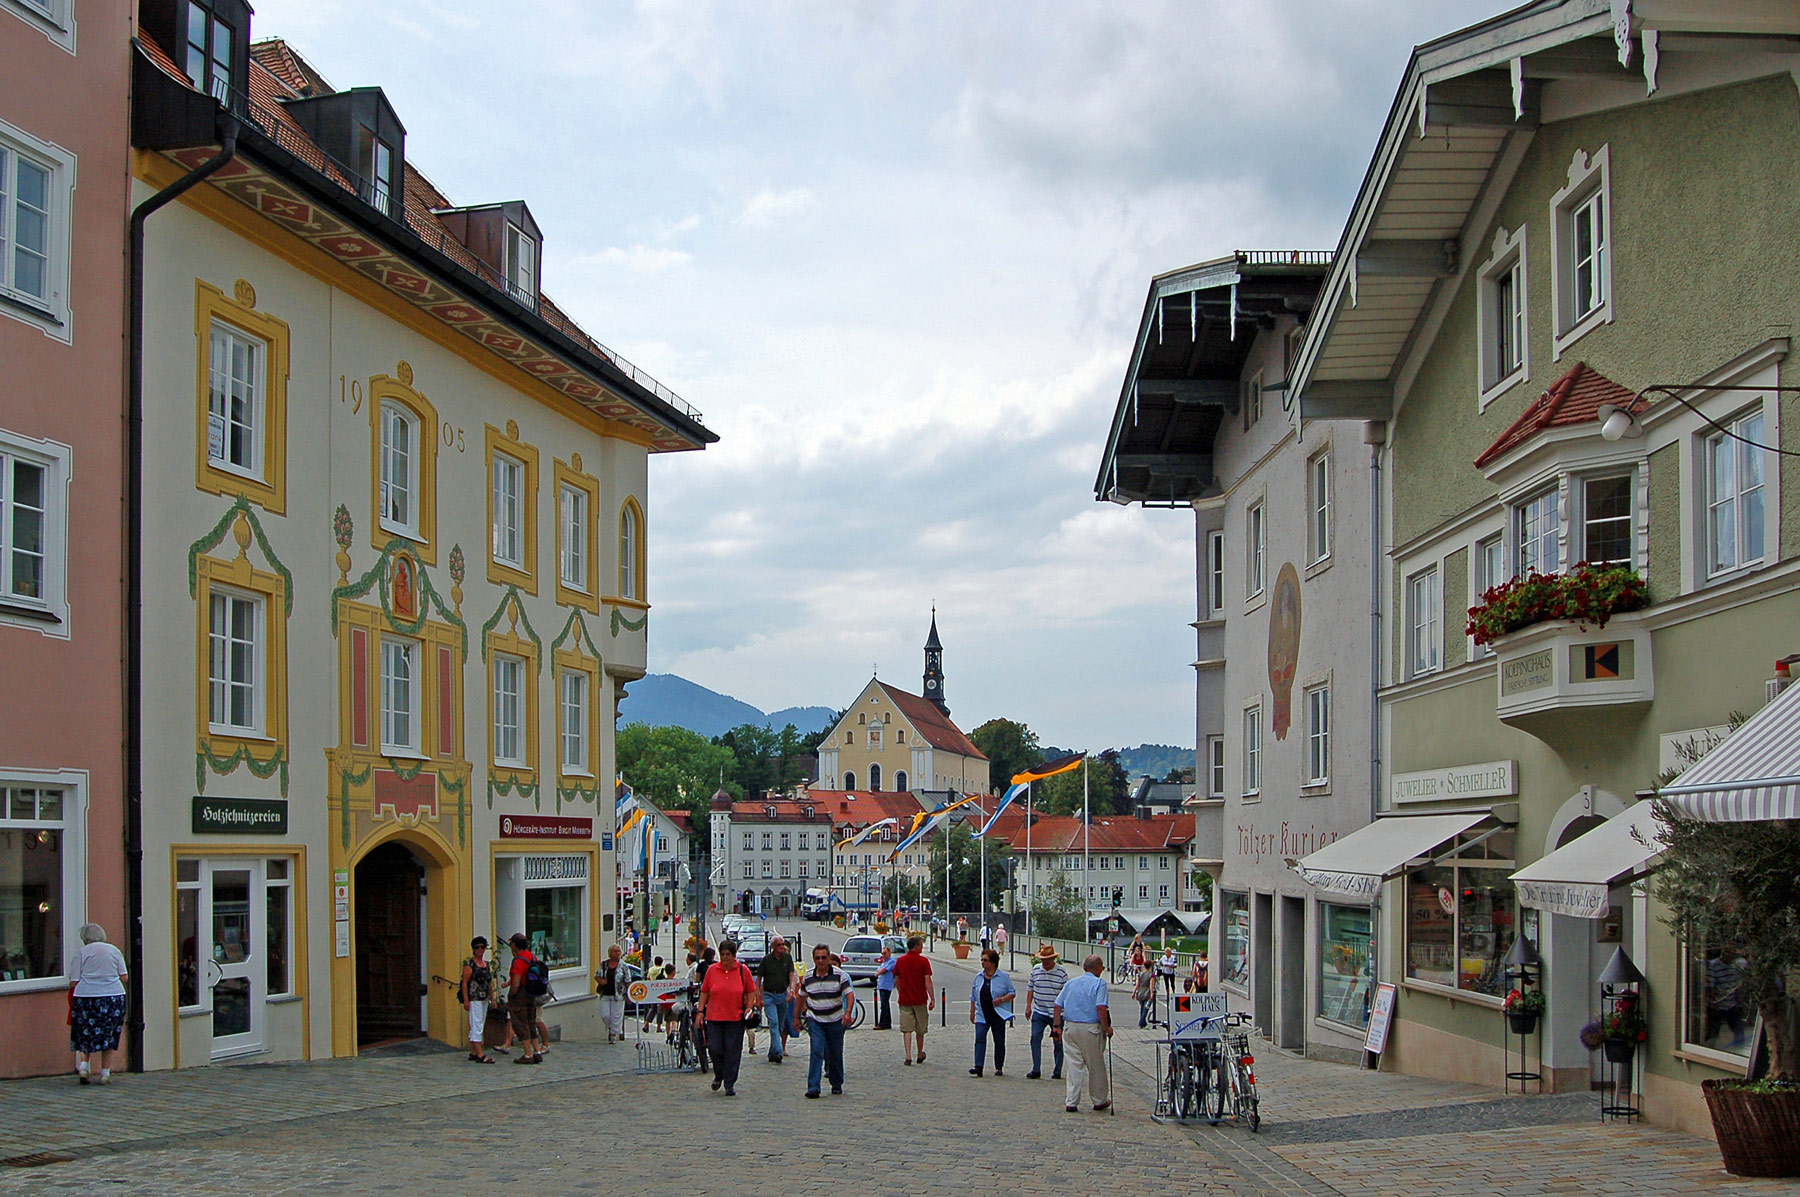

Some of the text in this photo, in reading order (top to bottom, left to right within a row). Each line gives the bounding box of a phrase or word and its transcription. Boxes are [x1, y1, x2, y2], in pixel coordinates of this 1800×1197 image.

[340, 374, 465, 453] 19 05
[1505, 653, 1551, 679] KOLPINGHAUS
[1396, 767, 1507, 798] JUWELIER SCHMELLER
[1583, 792, 1590, 809] 3
[202, 806, 281, 825] Holzschnitzereien
[1238, 821, 1338, 864] Tölzer Kurier
[1191, 995, 1220, 1004] KOLPING
[1201, 1004, 1220, 1012] HAUS
